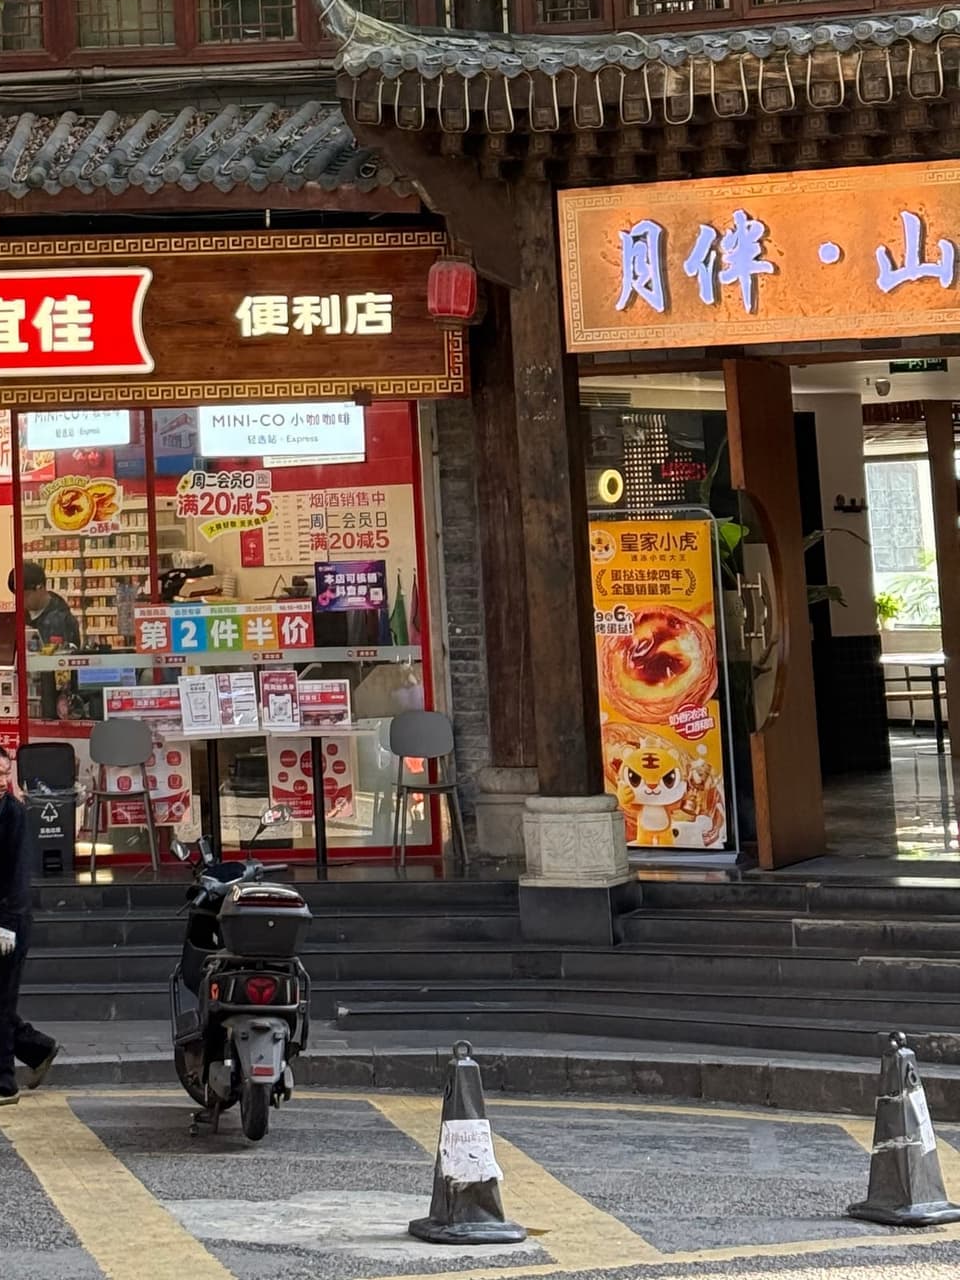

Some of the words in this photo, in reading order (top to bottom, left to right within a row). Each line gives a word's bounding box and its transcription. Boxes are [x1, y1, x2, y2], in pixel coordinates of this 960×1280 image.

[235, 292, 393, 337] 便利店
[212, 413, 286, 428] MINI-CO
[286, 433, 319, 445] Express
[190, 473, 255, 489] 周二会员日
[177, 491, 272, 516] 满20减5
[308, 491, 386, 508] 烟酒销售中
[310, 512, 388, 530] 周二会员日
[310, 531, 390, 551] 满20减5
[621, 532, 698, 552] 皇家小虎
[611, 569, 683, 581] 蛋挞连续四年
[611, 583, 683, 596] 全国销量第一
[139, 616, 309, 650] 第2件半价
